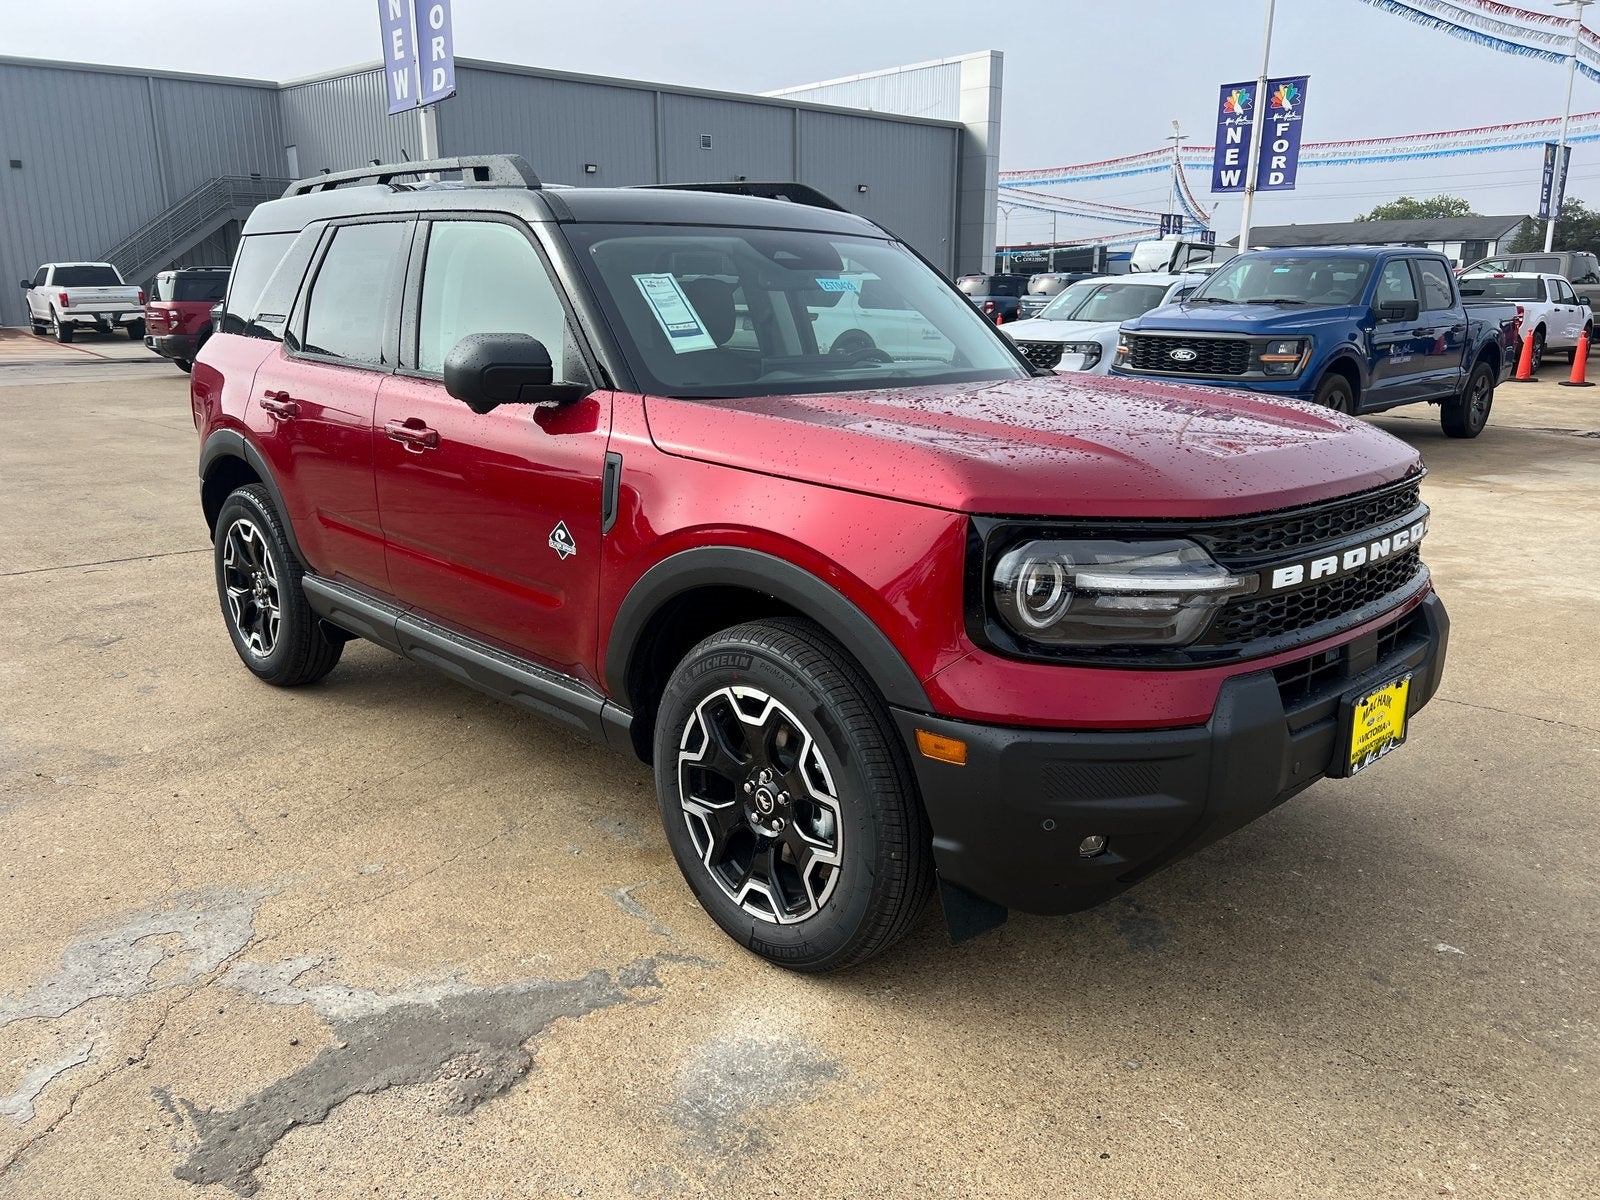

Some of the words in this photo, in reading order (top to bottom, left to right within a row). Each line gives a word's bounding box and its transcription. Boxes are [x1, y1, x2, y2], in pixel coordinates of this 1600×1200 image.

[1220, 127, 1242, 187] NEW
[1268, 123, 1290, 185] FORD
[1541, 173, 1549, 214] NEW
[1172, 350, 1193, 360] Ford
[1272, 521, 1424, 590] BRONCO
[692, 655, 750, 678] MICHELIN
[760, 662, 798, 690] PRIMACY
